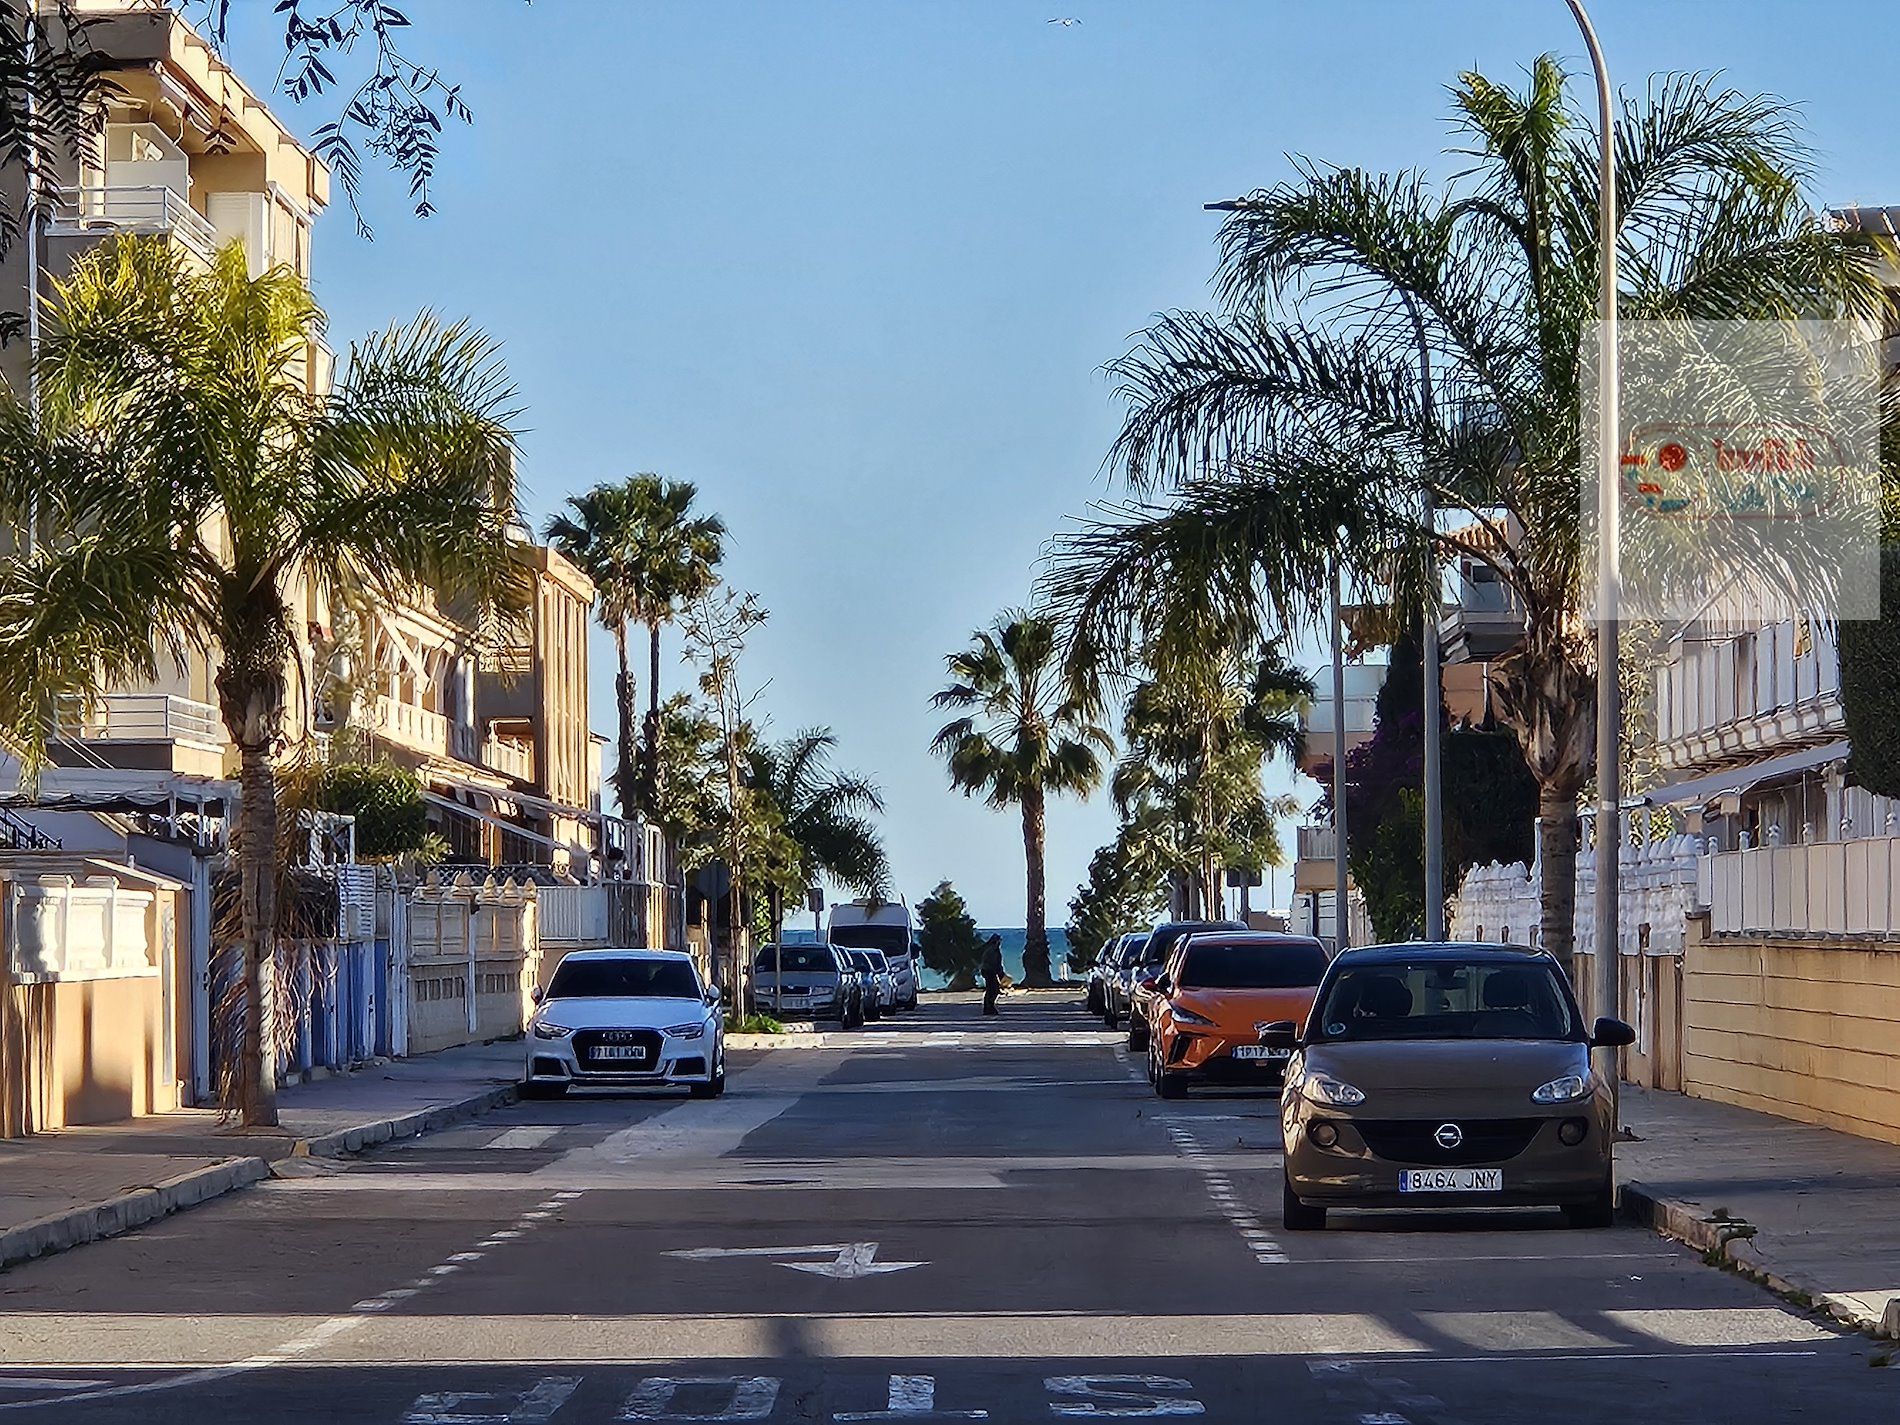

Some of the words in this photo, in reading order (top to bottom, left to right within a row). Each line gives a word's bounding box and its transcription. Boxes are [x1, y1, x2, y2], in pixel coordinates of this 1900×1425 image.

[1412, 1171, 1457, 1189] 8464
[1463, 1170, 1498, 1189] JNY
[404, 1373, 1206, 1425] STOP
